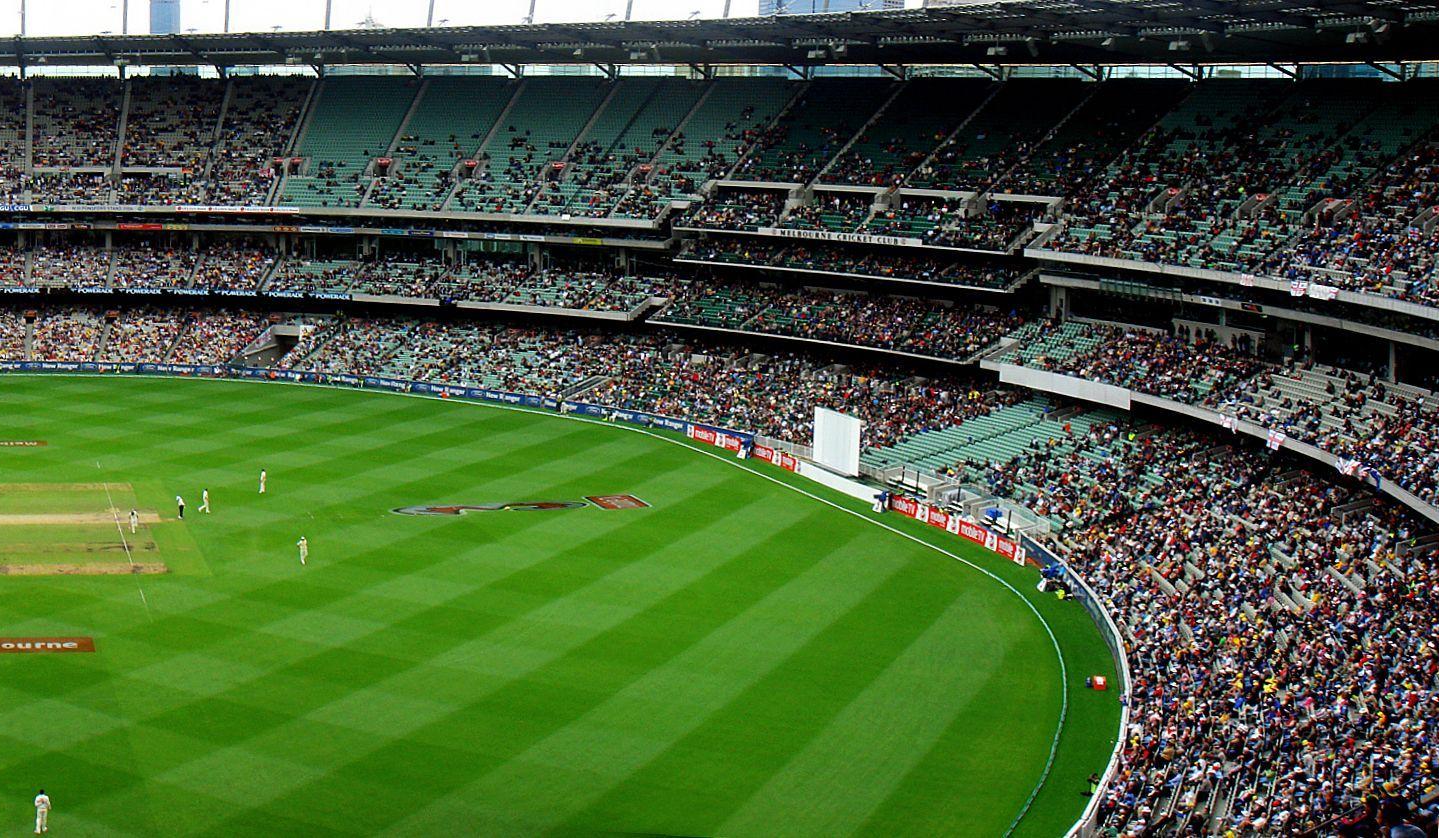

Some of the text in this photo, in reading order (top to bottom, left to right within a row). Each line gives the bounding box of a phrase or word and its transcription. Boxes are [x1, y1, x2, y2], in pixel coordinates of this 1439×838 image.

[780, 230, 898, 246] MELBOURNE CRICKET CLUB
